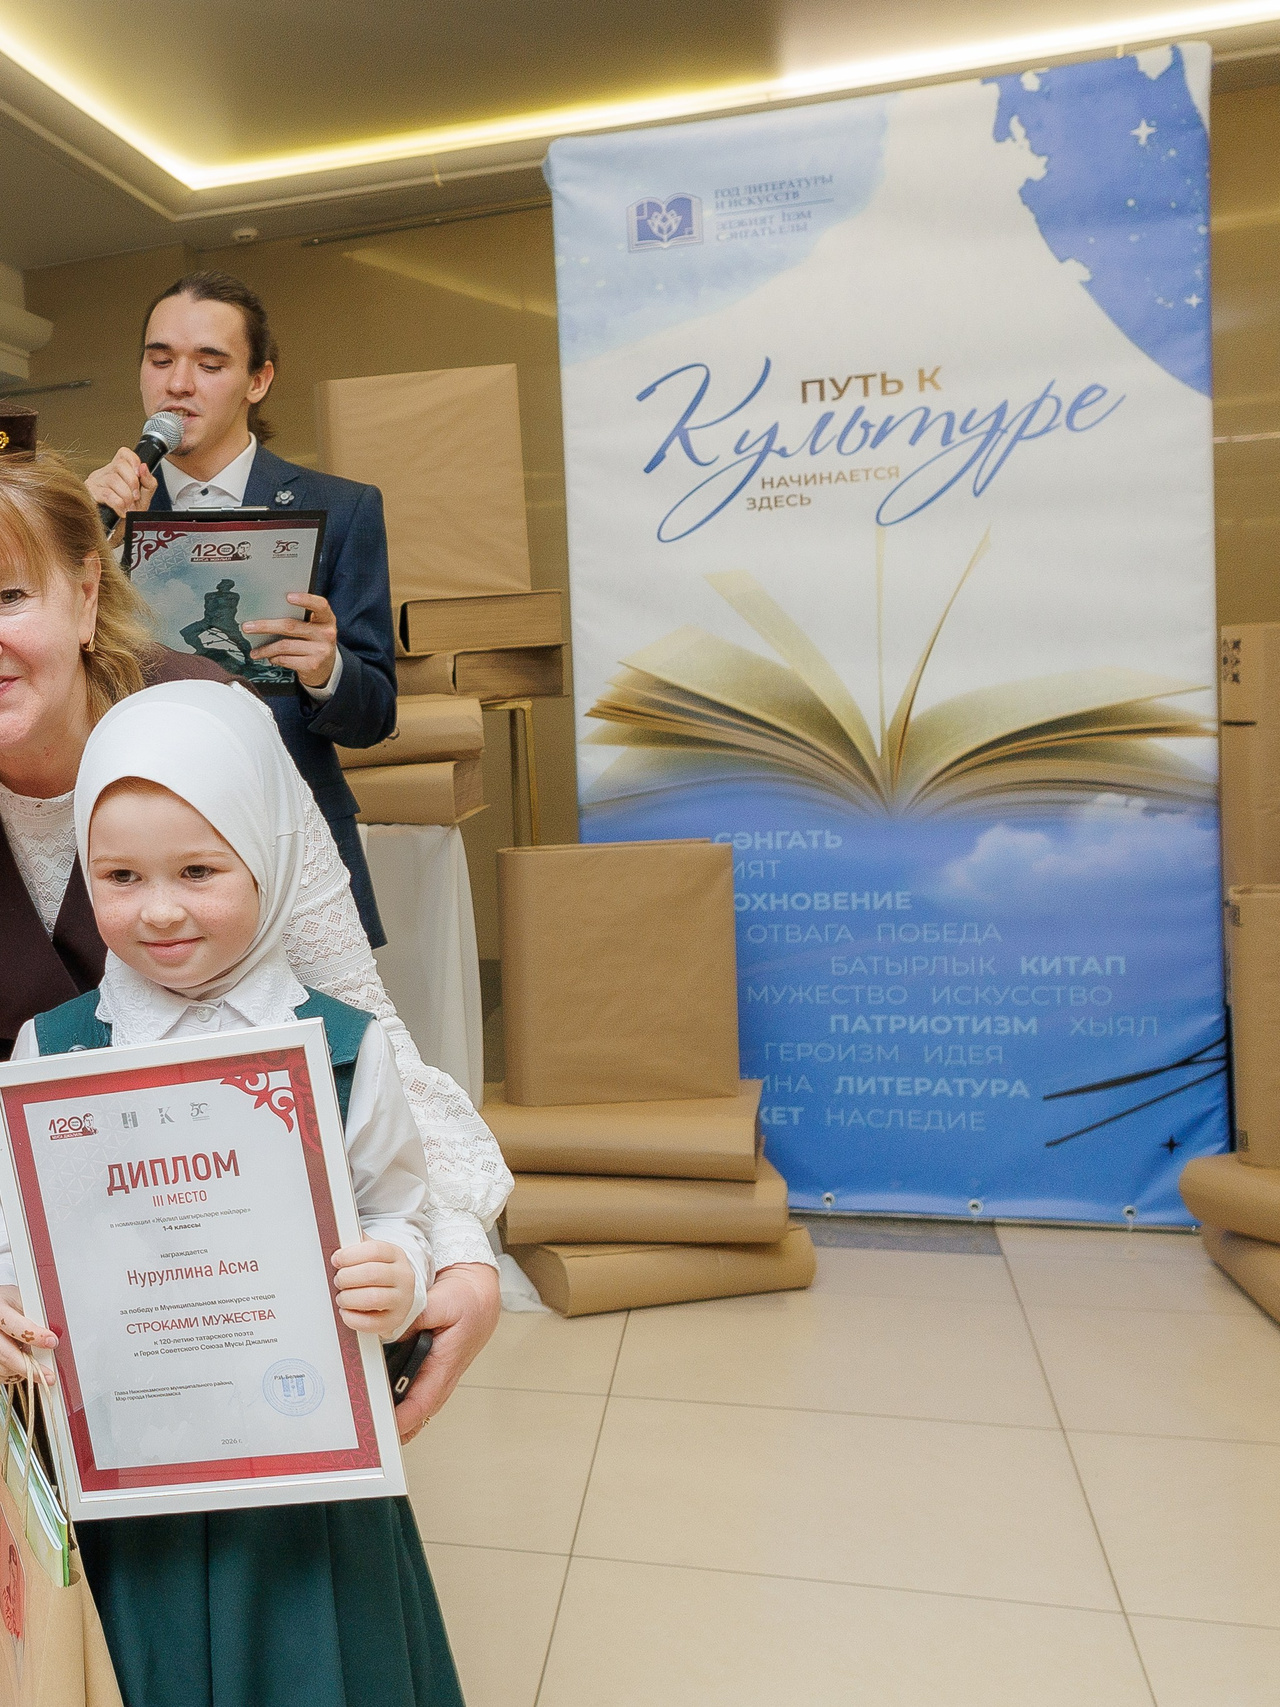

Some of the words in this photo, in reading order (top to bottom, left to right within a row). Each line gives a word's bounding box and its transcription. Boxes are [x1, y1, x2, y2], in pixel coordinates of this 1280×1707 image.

[800, 370, 904, 404] ПУТЬ
[918, 365, 943, 394] К
[636, 356, 1127, 543] Культуре
[760, 465, 901, 490] НАЧИНАЕТСЯ
[746, 493, 812, 513] ЗДЕСЬ
[734, 890, 913, 912] ОХНОВЕНИЕ
[747, 924, 854, 944] ОТВАГА
[877, 922, 1003, 947] ПОБЕДА
[830, 955, 997, 978] БАТЫРЛЫК
[1020, 956, 1126, 976] КИТАП
[747, 983, 909, 1006] МУЖЕСТВО
[932, 983, 1113, 1007] ИСКУССТВО
[830, 1014, 1038, 1037] ПАТРИОТИЗМ
[1070, 1015, 1159, 1039] ХЫЯЛ
[764, 1042, 899, 1063] ГЕРОИЗМ
[923, 1044, 1003, 1067] ИДЕЯ
[835, 1076, 1030, 1100] ЛИТЕРАТУРА
[49, 1116, 83, 1134] 120
[825, 1107, 987, 1133] НАСЛЕДИЕ
[107, 1149, 240, 1196] ДИПЛОМ
[152, 1195, 164, 1207] III
[167, 1190, 207, 1205] МЕСТО
[115, 1219, 150, 1228] номинации
[160, 1248, 208, 1259] награждается
[127, 1264, 213, 1288] Нуруллина
[218, 1259, 259, 1276] Асма
[129, 1306, 153, 1315] победу
[160, 1299, 217, 1312] Муниципальном
[217, 1295, 250, 1306] конкурсе
[251, 1293, 276, 1301] чтецов
[126, 1317, 199, 1335] СТРОКАМИ
[202, 1309, 276, 1327] МУЖЕСТВА
[139, 1349, 159, 1358] Героя
[160, 1345, 200, 1354] Советского
[200, 1343, 223, 1351] Союза
[224, 1341, 244, 1349] Мусы
[245, 1337, 278, 1346] Джалиля
[159, 1336, 195, 1345] 120-летию
[195, 1333, 233, 1342] татарского
